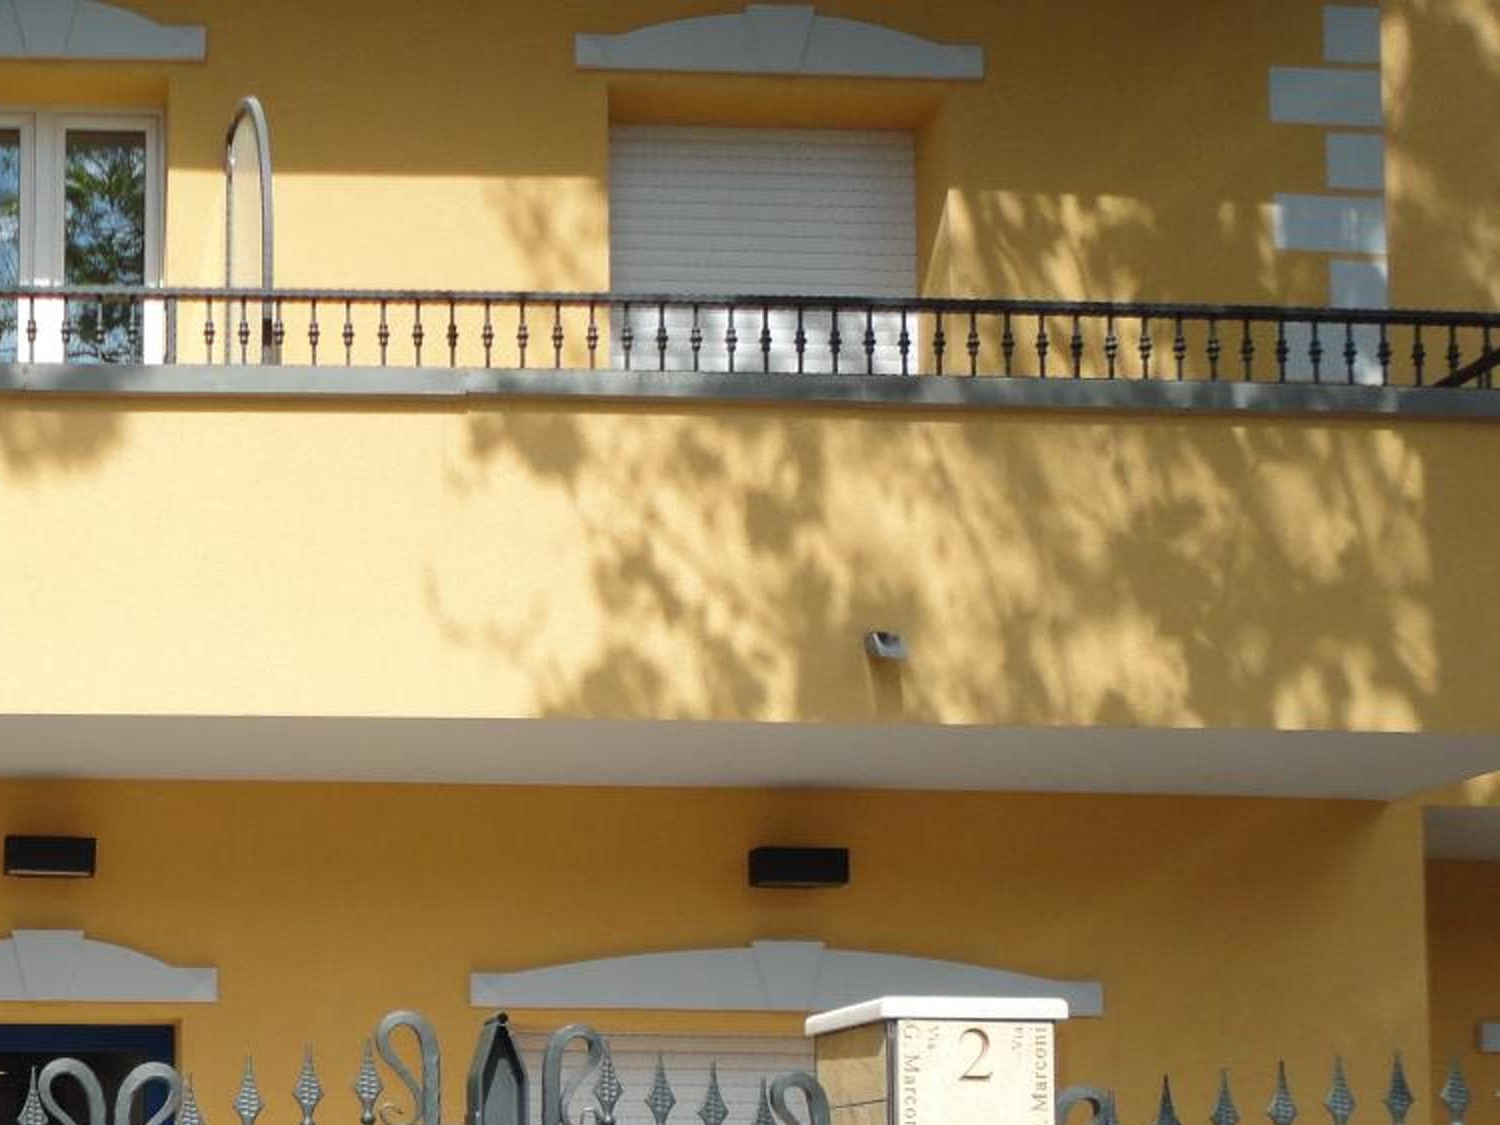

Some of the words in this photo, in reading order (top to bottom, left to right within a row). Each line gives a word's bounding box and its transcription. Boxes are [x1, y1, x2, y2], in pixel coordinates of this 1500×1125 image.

[903, 1022, 920, 1049] G.
[927, 1025, 940, 1050] Via
[1011, 1026, 1024, 1051] Via
[959, 1027, 994, 1081] 2
[1030, 1027, 1048, 1112] Marconi
